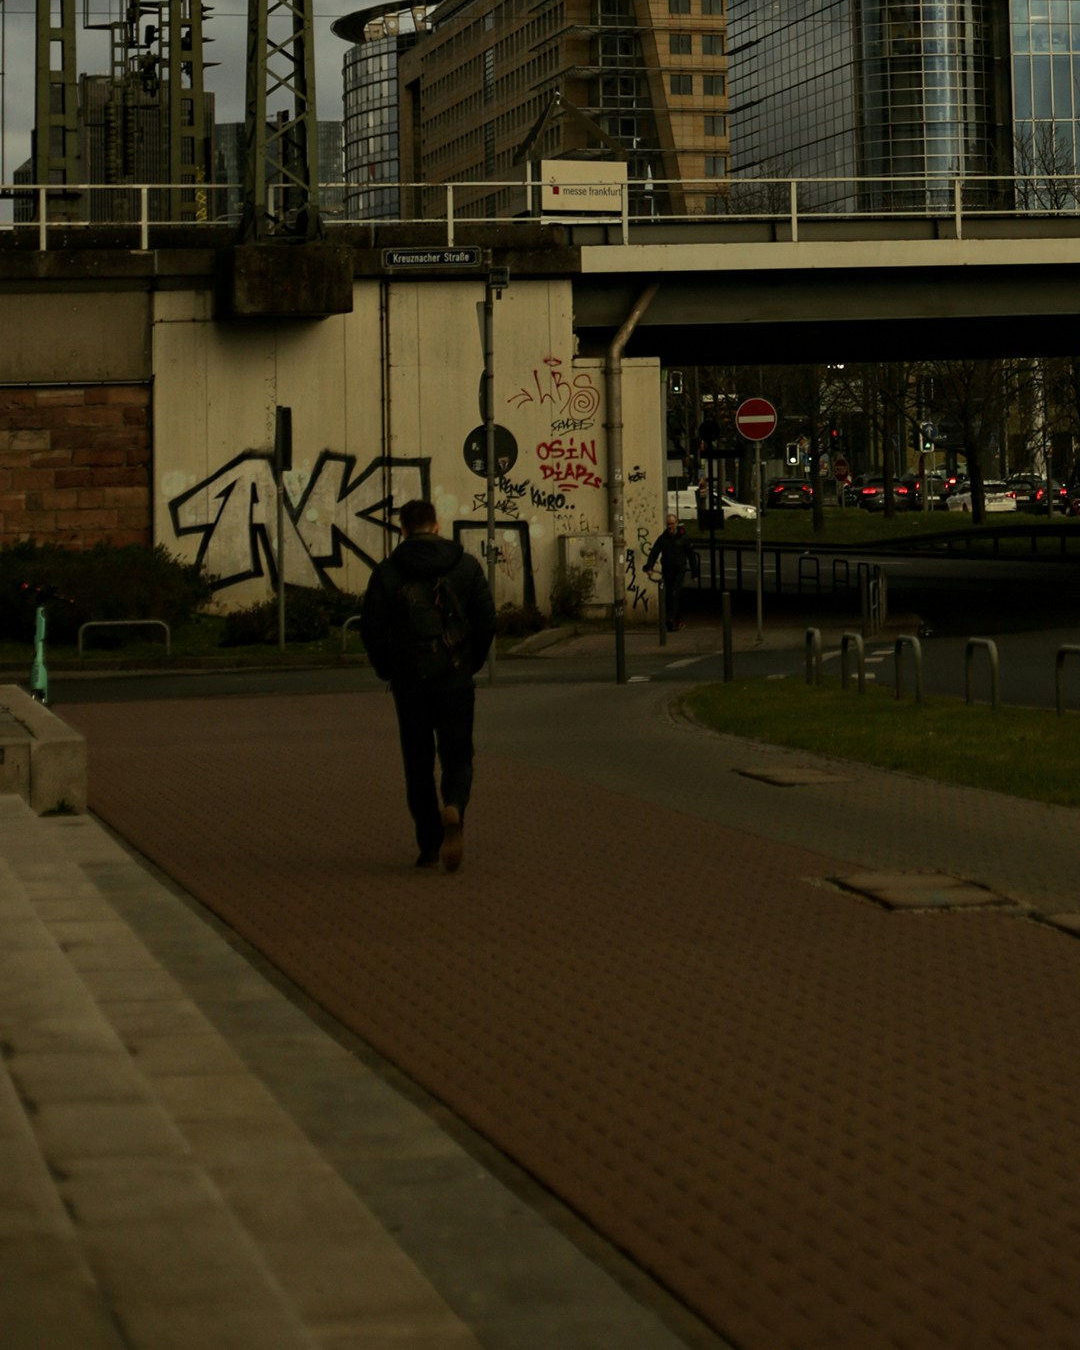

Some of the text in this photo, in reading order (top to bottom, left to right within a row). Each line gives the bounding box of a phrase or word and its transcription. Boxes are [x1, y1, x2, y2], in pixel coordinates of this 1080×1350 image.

[562, 186, 622, 197] messe frankfurt
[392, 252, 470, 263] Kreuznacher Straße
